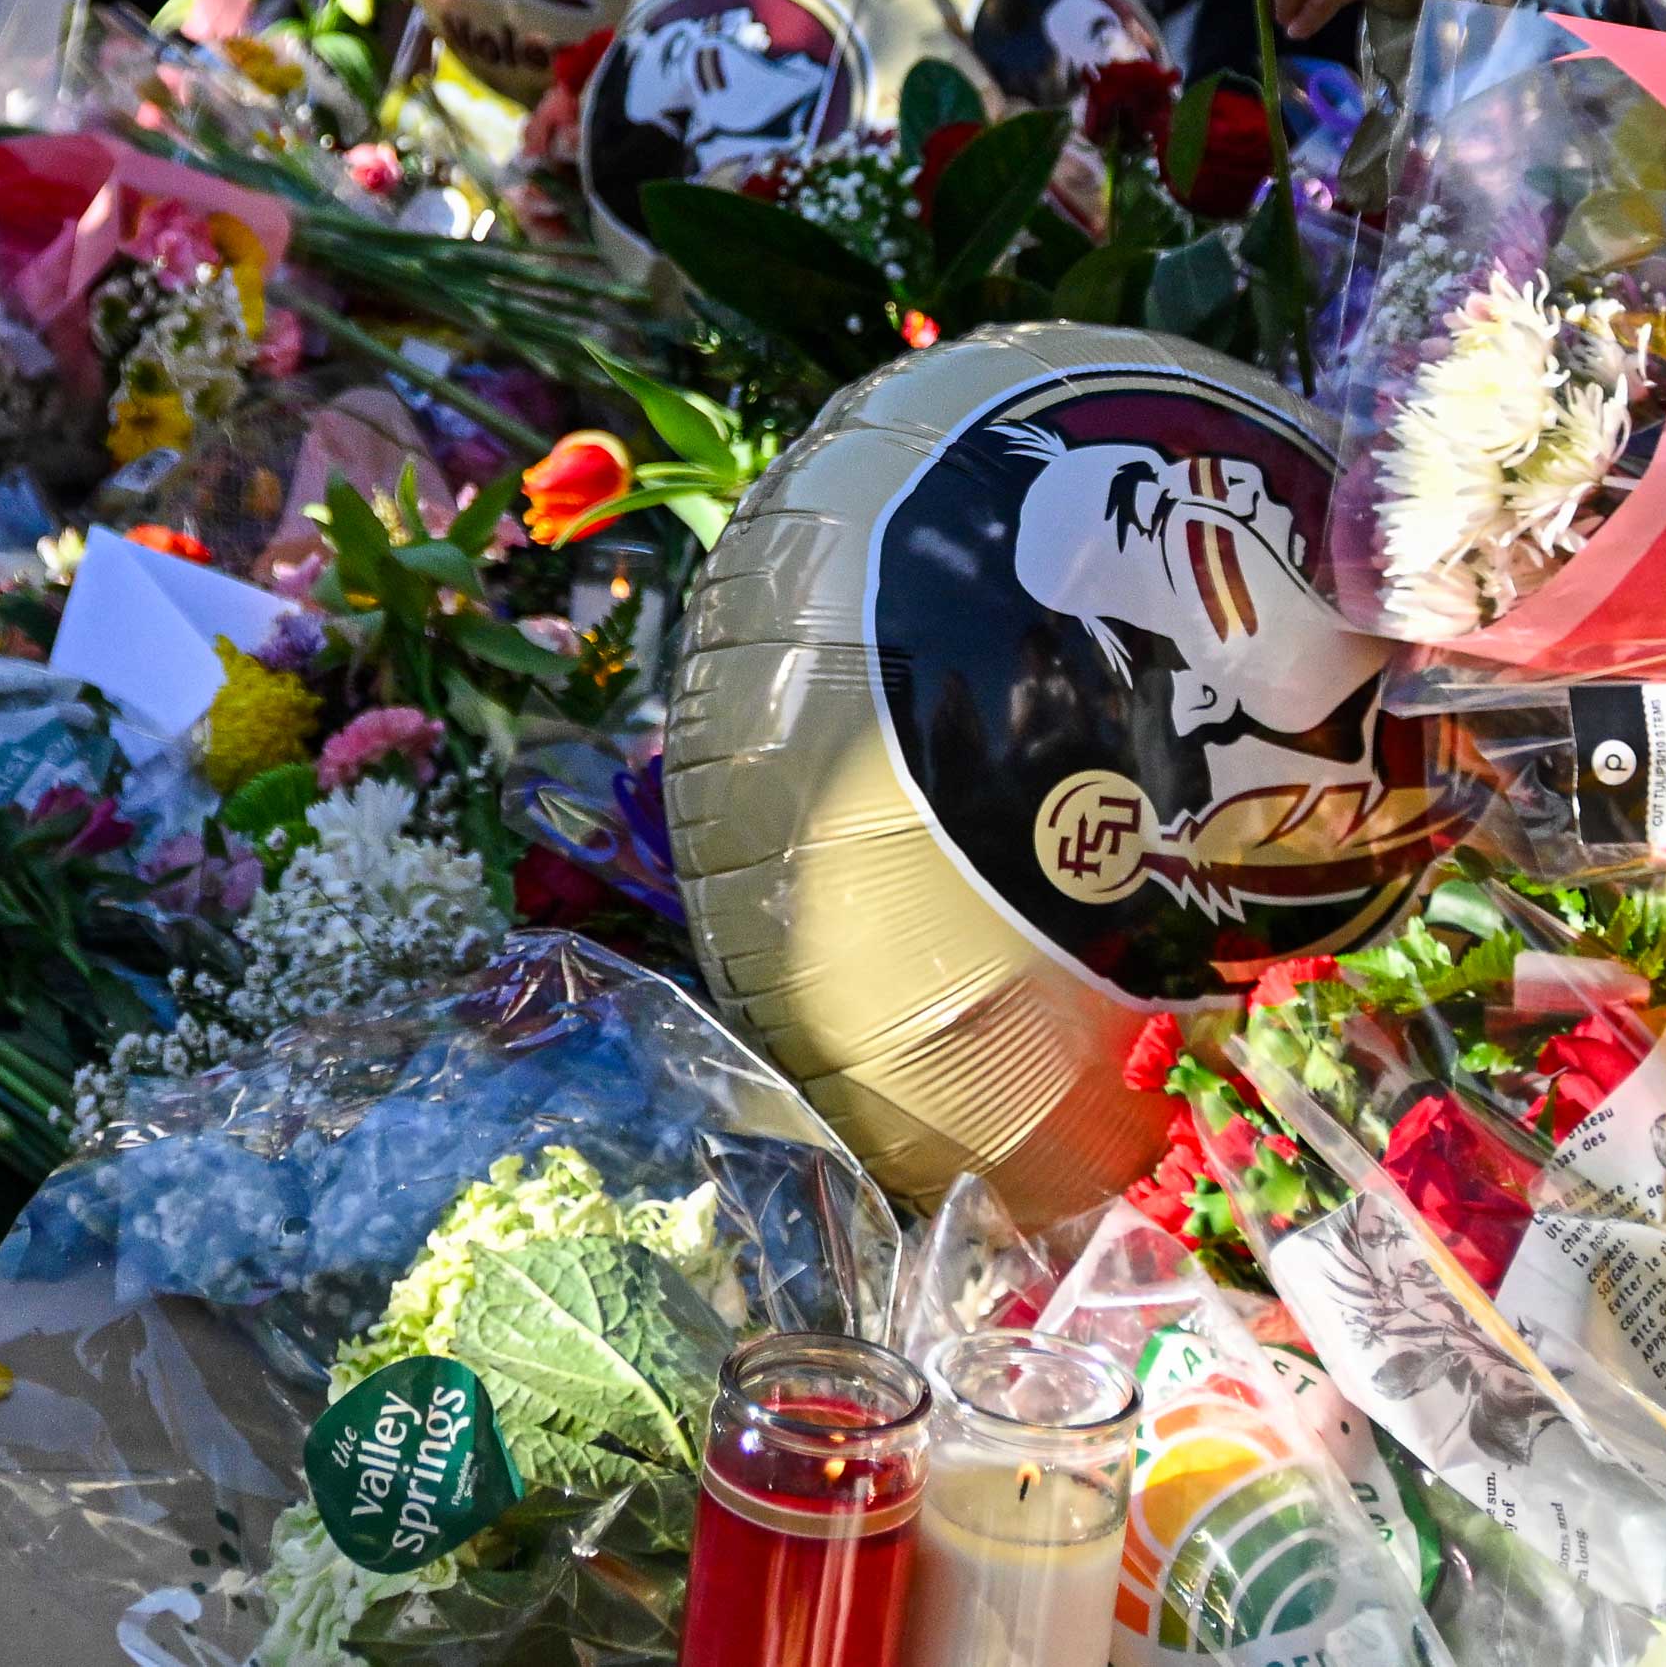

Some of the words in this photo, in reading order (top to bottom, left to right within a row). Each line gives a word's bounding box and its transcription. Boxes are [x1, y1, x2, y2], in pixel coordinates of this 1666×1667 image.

[441, 11, 550, 71] Nole
[1581, 1132, 1607, 1151] des
[1645, 1256, 1662, 1273] le
[1620, 1277, 1666, 1332] courants
[331, 1425, 358, 1469] the
[392, 1386, 471, 1554] springs
[1486, 1472, 1497, 1505] sun.
[1501, 1499, 1516, 1518] of
[1550, 1501, 1568, 1531] and
